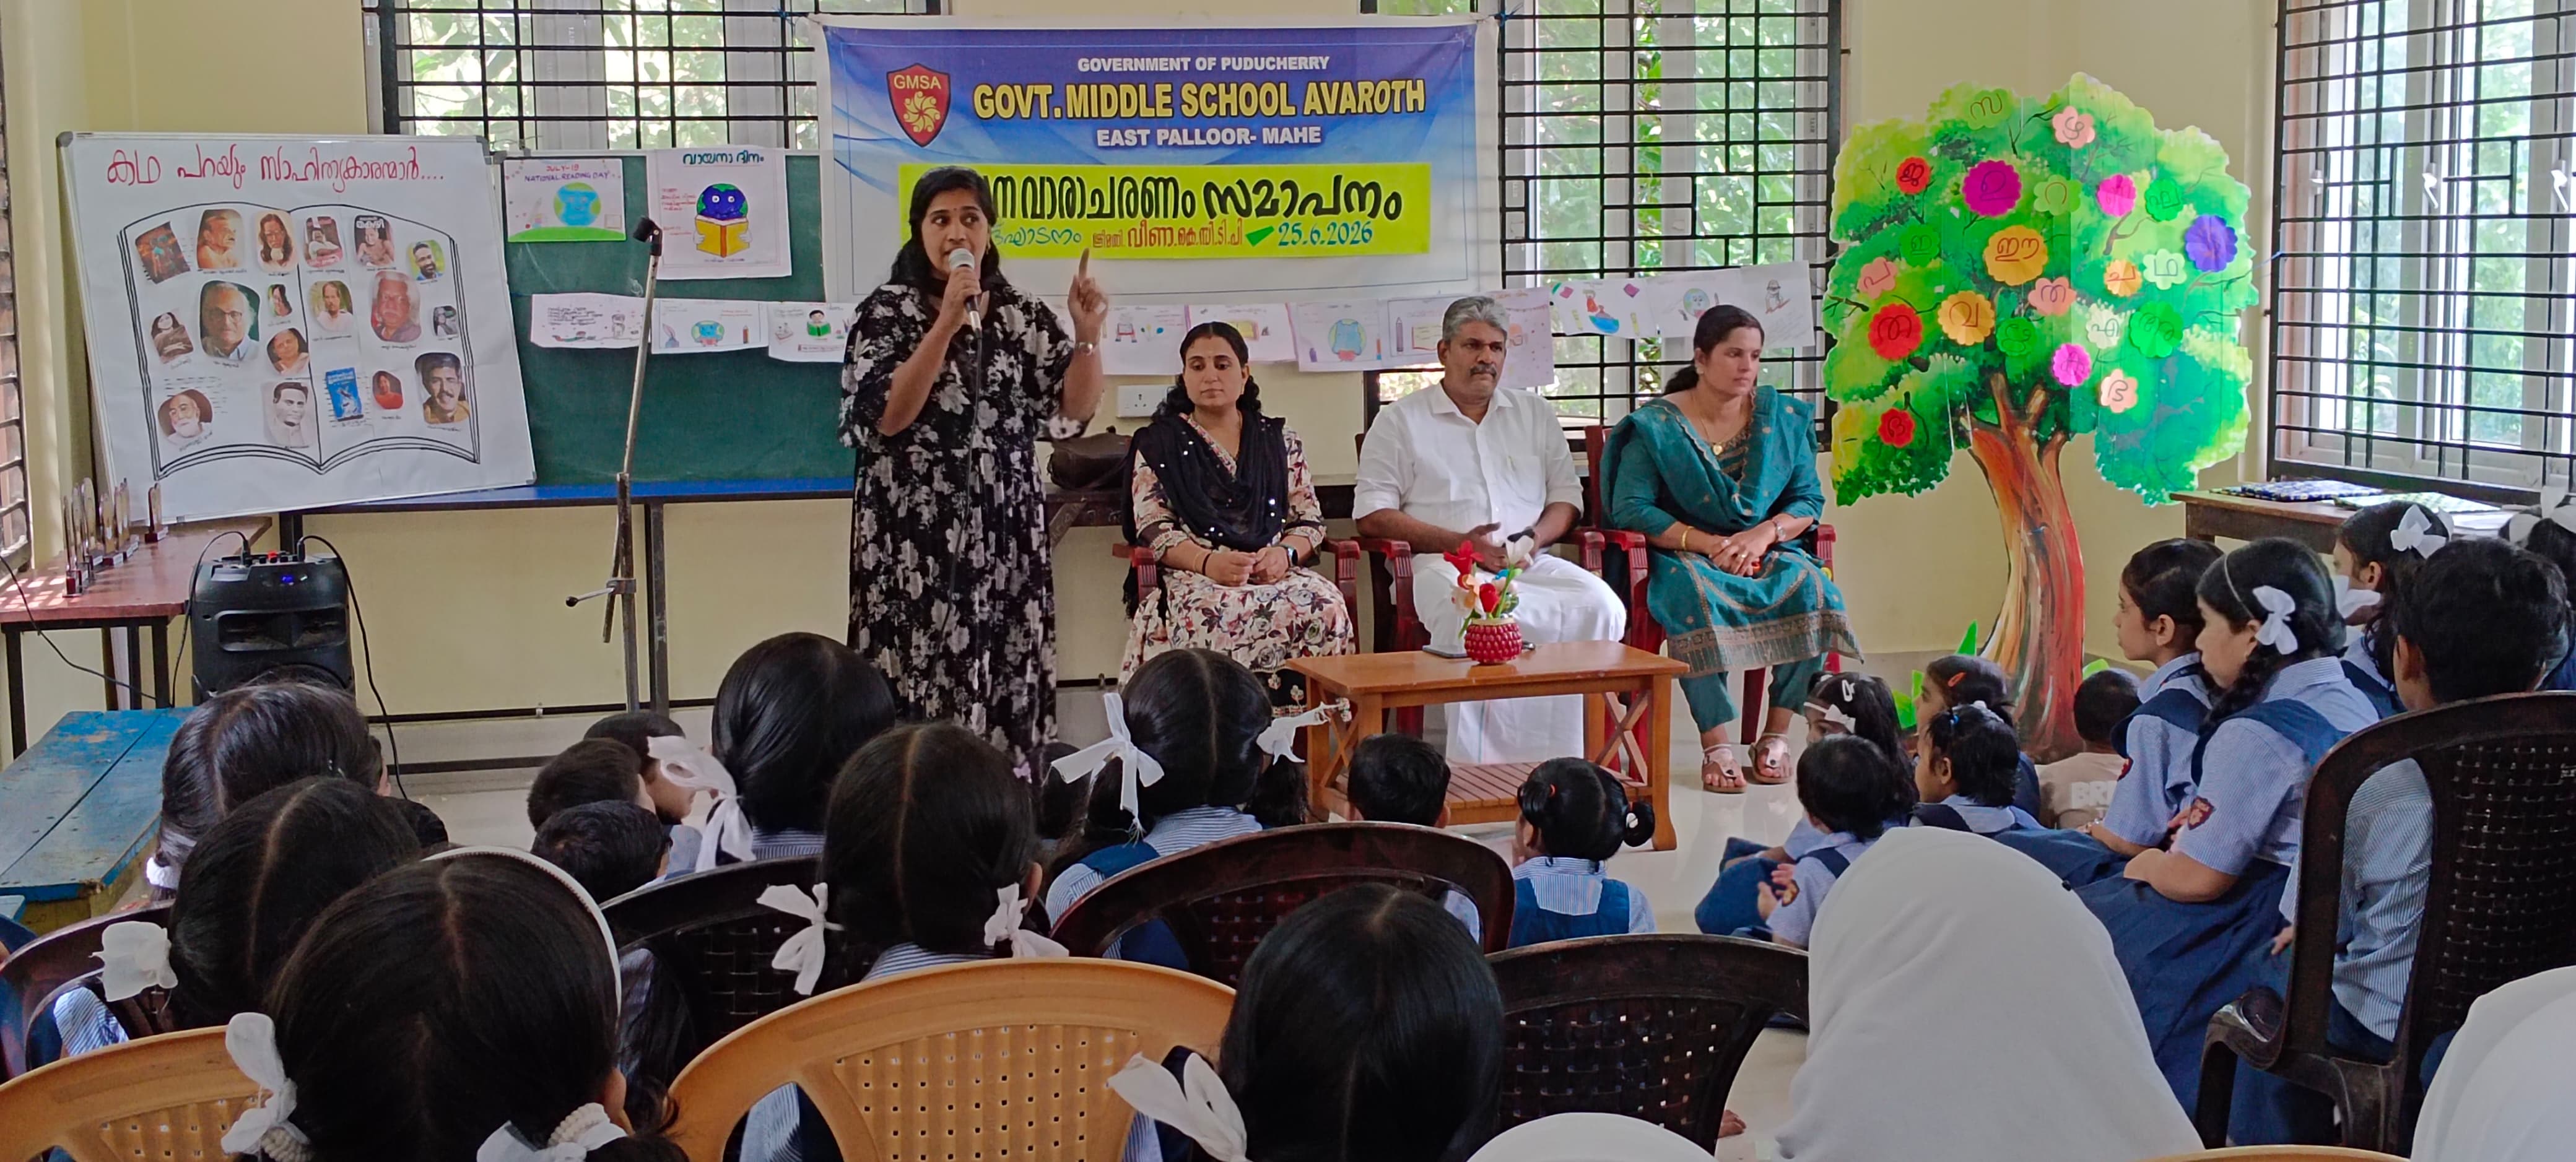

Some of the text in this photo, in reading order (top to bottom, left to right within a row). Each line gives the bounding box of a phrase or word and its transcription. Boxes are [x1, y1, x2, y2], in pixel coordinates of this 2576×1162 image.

[1077, 56, 1329, 72] GOVERNMENT OF PUDUCHERRY
[894, 74, 942, 90] GMSA
[1181, 81, 1297, 118] SCHOOL
[1302, 79, 1425, 116] AVAROTH
[1970, 93, 2003, 120] സ
[1097, 126, 1321, 147] EAST PALLOOR- MAHE
[107, 149, 161, 186] കഥ
[177, 143, 246, 190] പറയും
[682, 149, 765, 165] വായനാ ദിനം
[524, 174, 560, 182] NATIONAL
[562, 171, 591, 181] READING
[1203, 174, 1403, 221] സമാപനം
[1277, 220, 1373, 246] 25.6.2026
[1995, 237, 2040, 262] ഈ
[1863, 261, 1891, 290] പ
[2040, 284, 2066, 303] ത
[1949, 301, 1979, 328] വ
